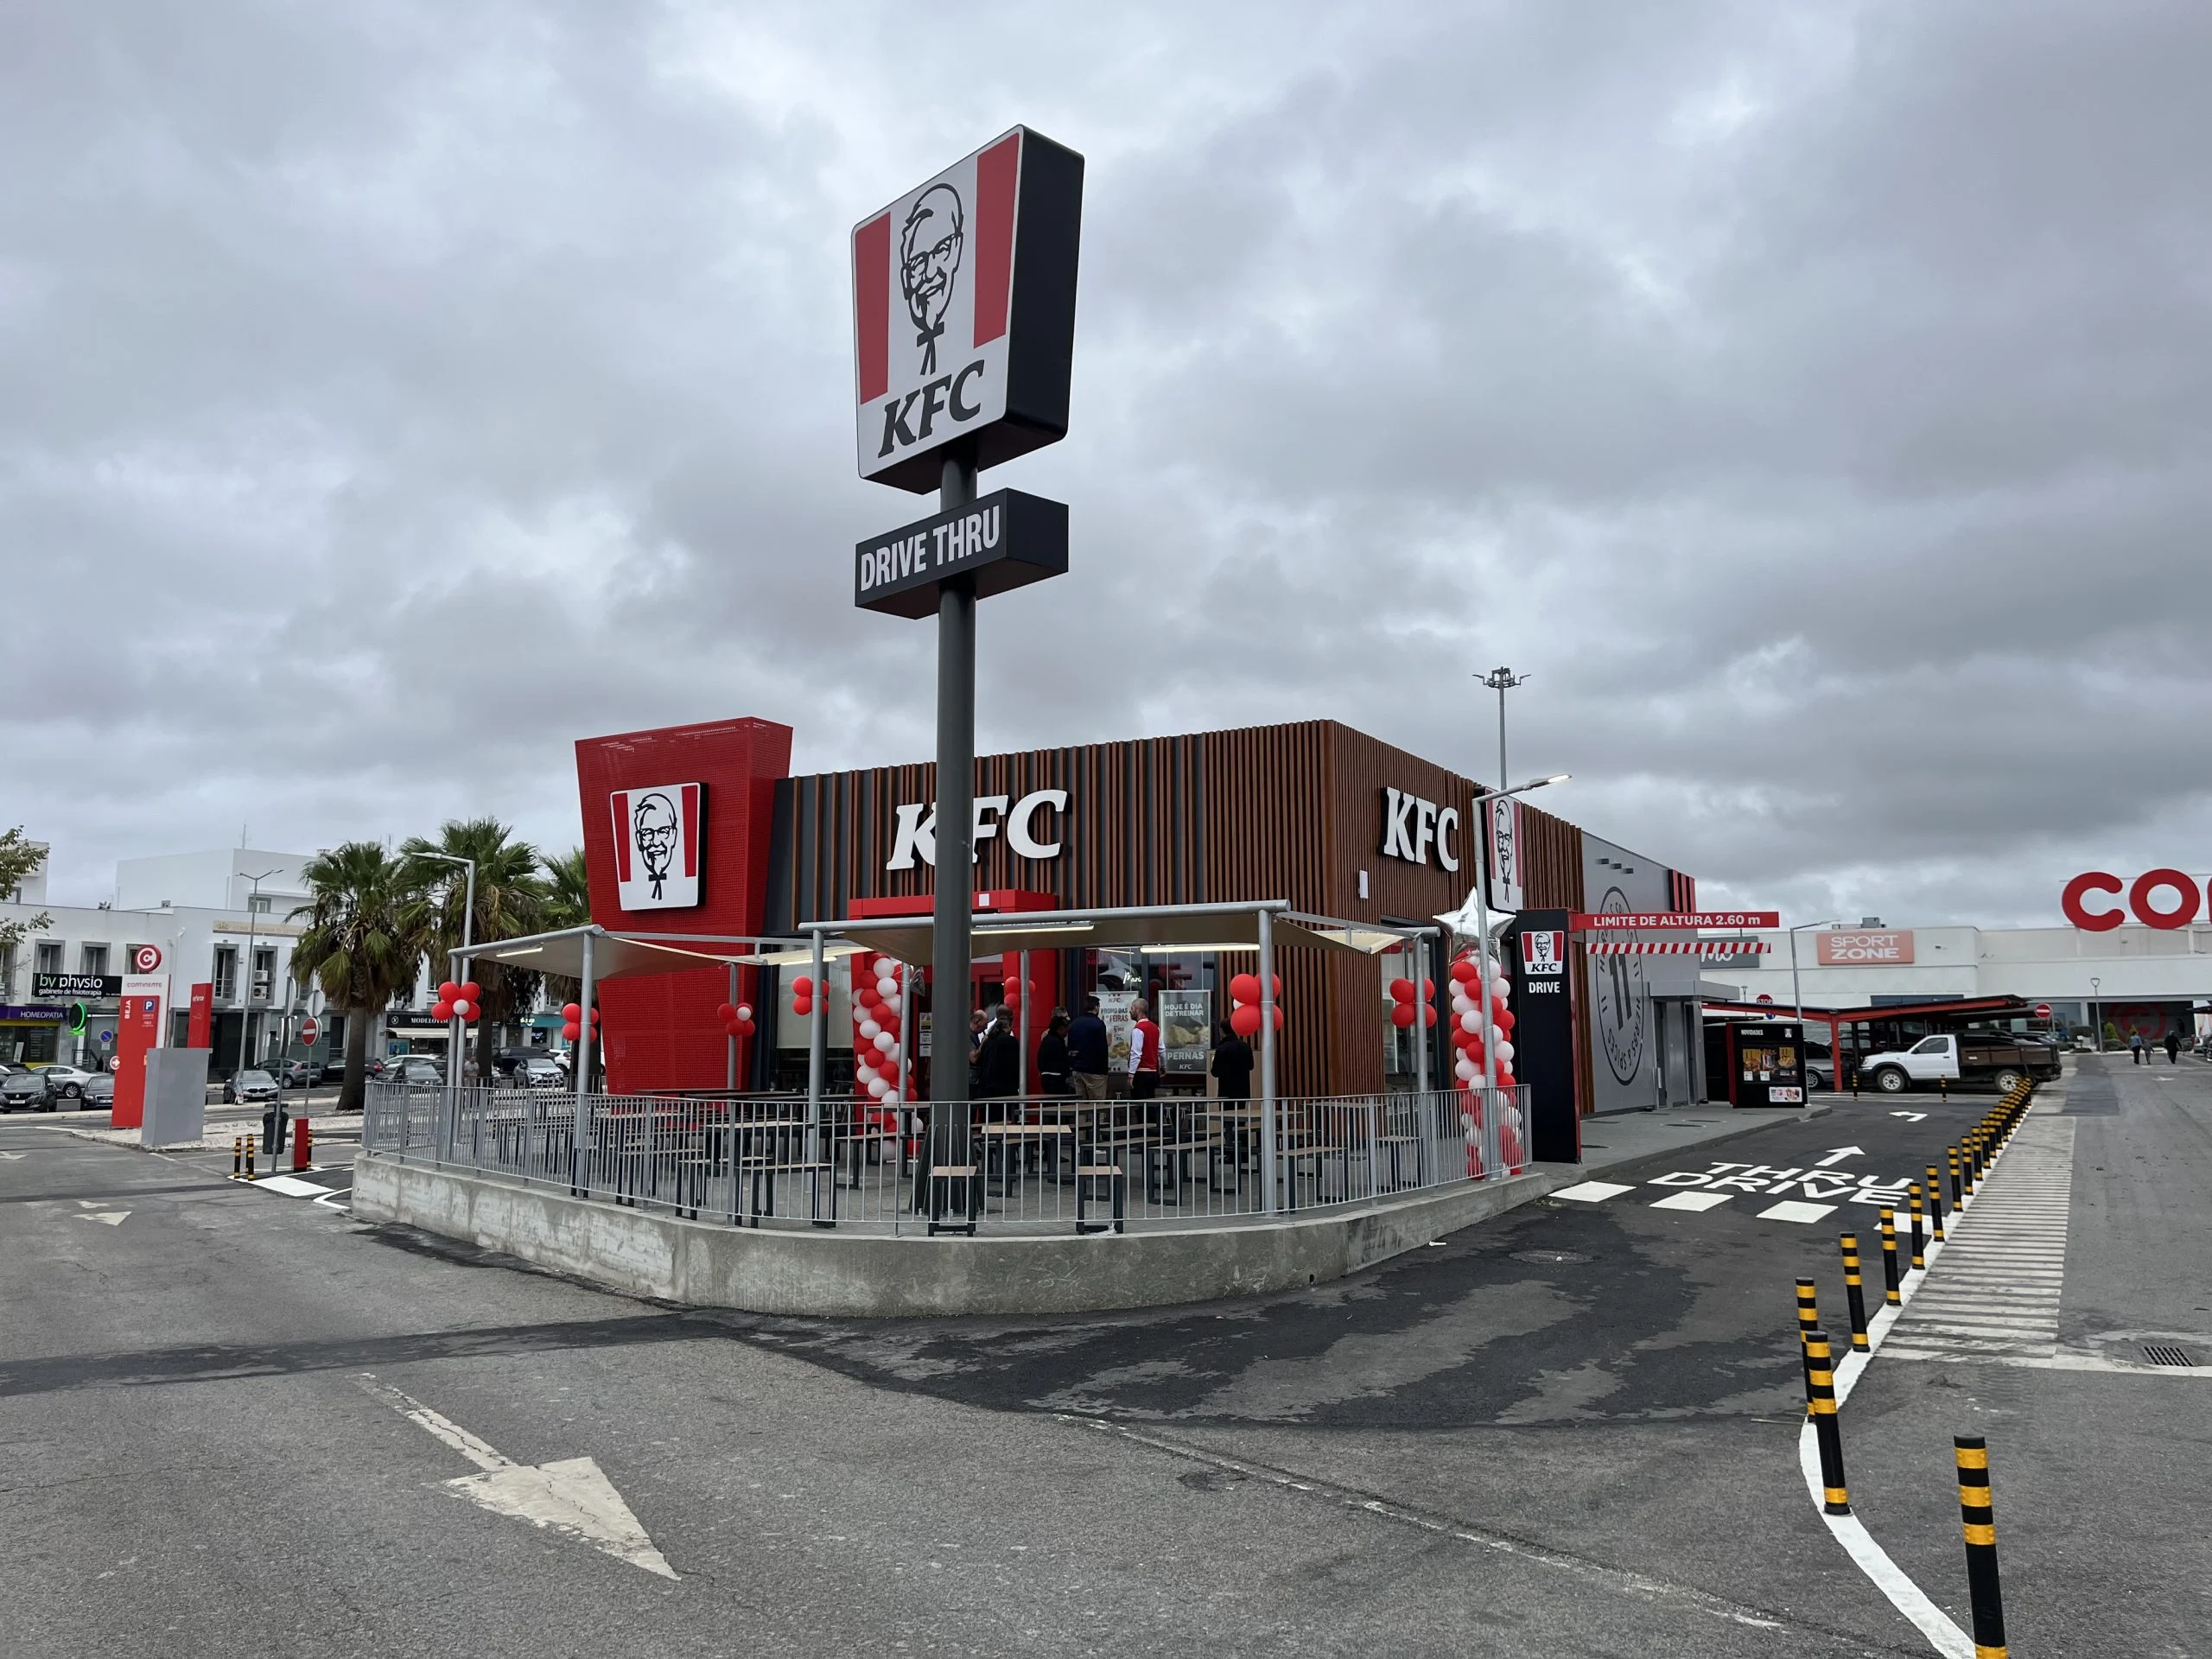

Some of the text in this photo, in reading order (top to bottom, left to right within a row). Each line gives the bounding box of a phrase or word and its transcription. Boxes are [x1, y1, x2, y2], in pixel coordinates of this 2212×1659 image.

[878, 359, 985, 458] KFC
[861, 505, 1000, 592] DRIVE THRU
[886, 789, 1068, 870] KFC
[1383, 786, 1459, 872] KFC
[2062, 868, 2212, 931] CO
[1593, 916, 1636, 926] LIMITE
[1639, 916, 1656, 926] DE
[1660, 916, 1713, 925] ALTURA
[1716, 915, 1745, 925] 2.60
[1831, 935, 1898, 947] SPORT
[1831, 948, 1900, 959] ZONE
[1531, 963, 1557, 972] KFC
[39, 974, 103, 988] by physio
[1529, 982, 1560, 993] DRIVE
[1167, 1052, 1205, 1060] PERNAS
[1710, 1162, 1914, 1190] THRU
[1647, 1172, 1910, 1207] DRIVE
